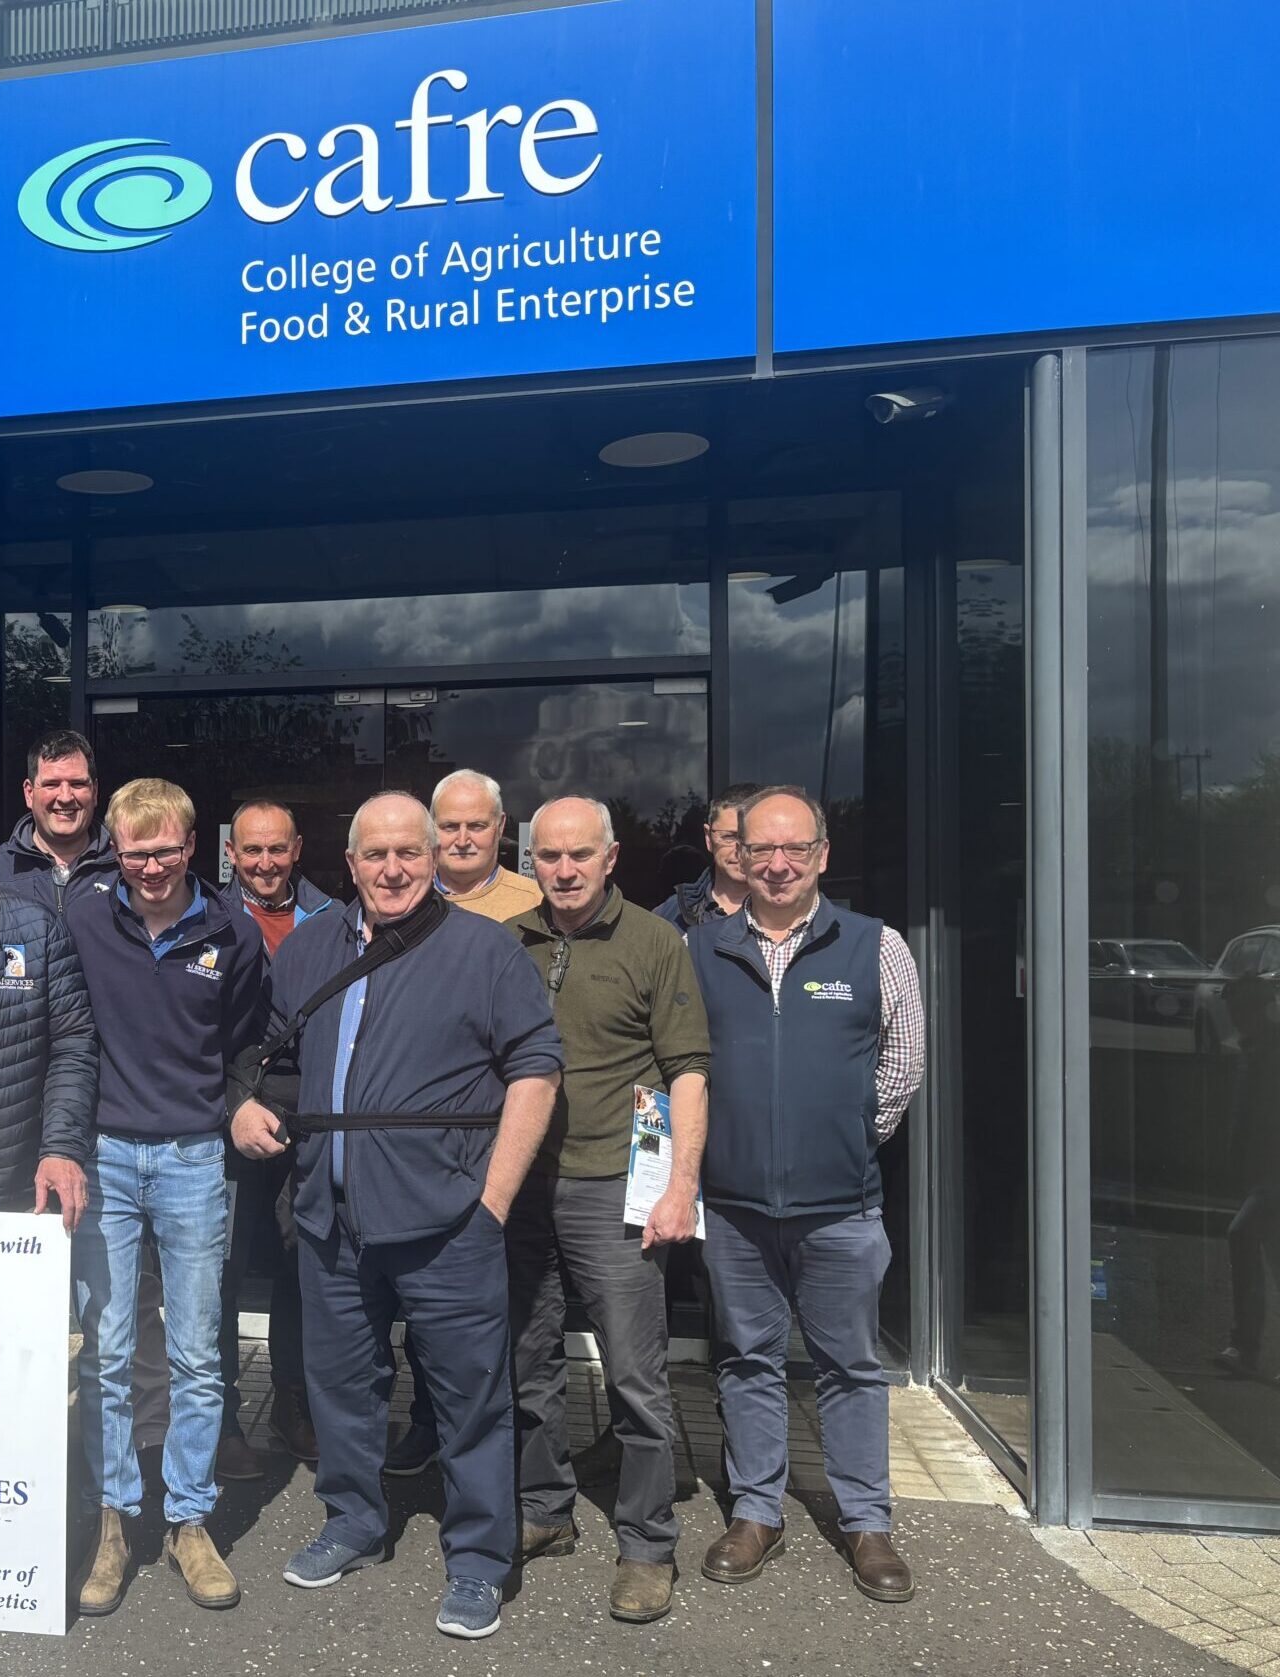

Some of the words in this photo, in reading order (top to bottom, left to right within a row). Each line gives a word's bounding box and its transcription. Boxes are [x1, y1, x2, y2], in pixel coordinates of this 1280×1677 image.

[235, 69, 602, 223] cafre
[241, 253, 376, 295] College
[390, 241, 429, 280] of
[441, 227, 661, 282] Agriculture
[241, 302, 328, 345] Food
[344, 301, 370, 335] &
[386, 289, 479, 332] Rural
[497, 274, 695, 323] Enterprise
[822, 980, 852, 992] cafre
[0, 1236, 43, 1255] with
[16, 1565, 39, 1587] of
